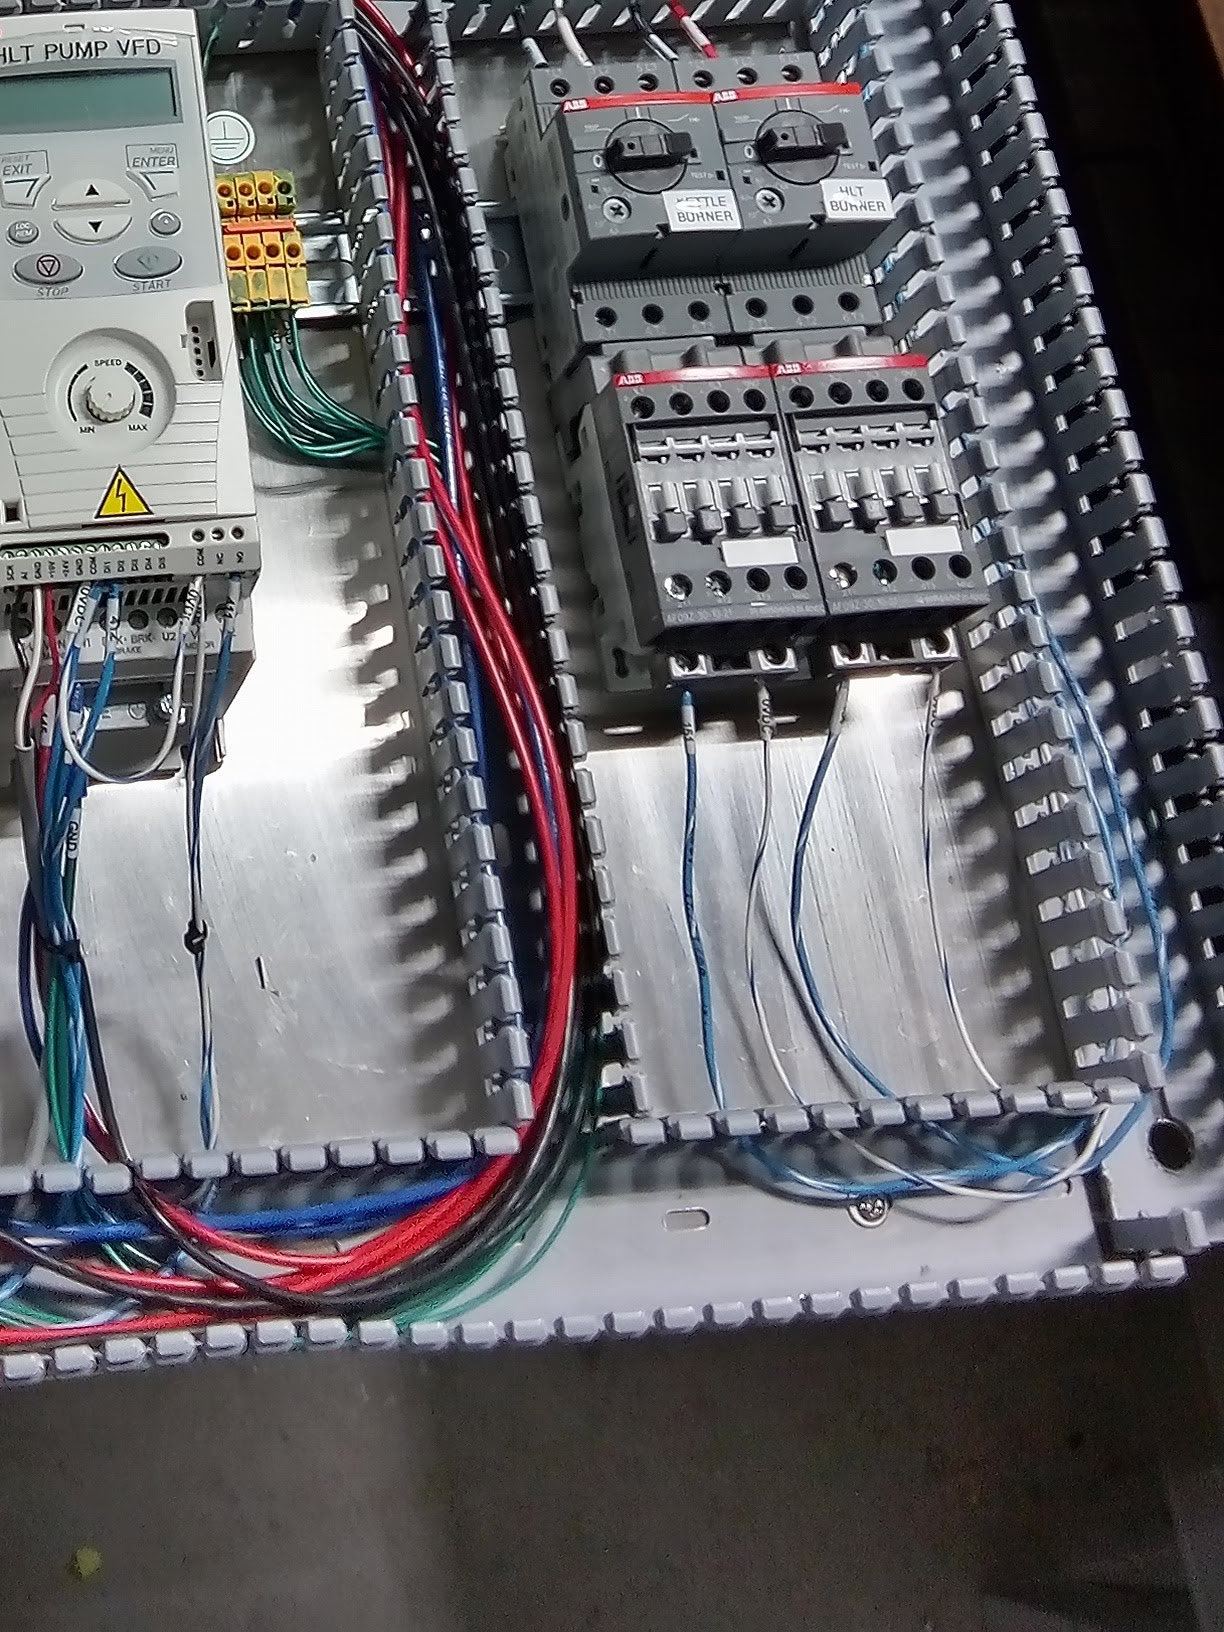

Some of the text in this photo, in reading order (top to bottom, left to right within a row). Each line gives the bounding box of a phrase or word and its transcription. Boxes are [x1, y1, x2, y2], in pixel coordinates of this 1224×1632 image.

[45, 41, 108, 60] PUMP
[116, 39, 161, 56] VFD
[714, 91, 738, 102] ABB
[563, 99, 589, 112] ABB
[132, 157, 176, 167] ENTER
[3, 164, 33, 176] EXIT
[677, 211, 733, 223] BURNER
[37, 286, 69, 296] STOP
[132, 280, 172, 291] START
[777, 362, 801, 375] ABB
[618, 373, 644, 386] ABB
[162, 632, 176, 641] U2
[66, 821, 79, 852] GND
